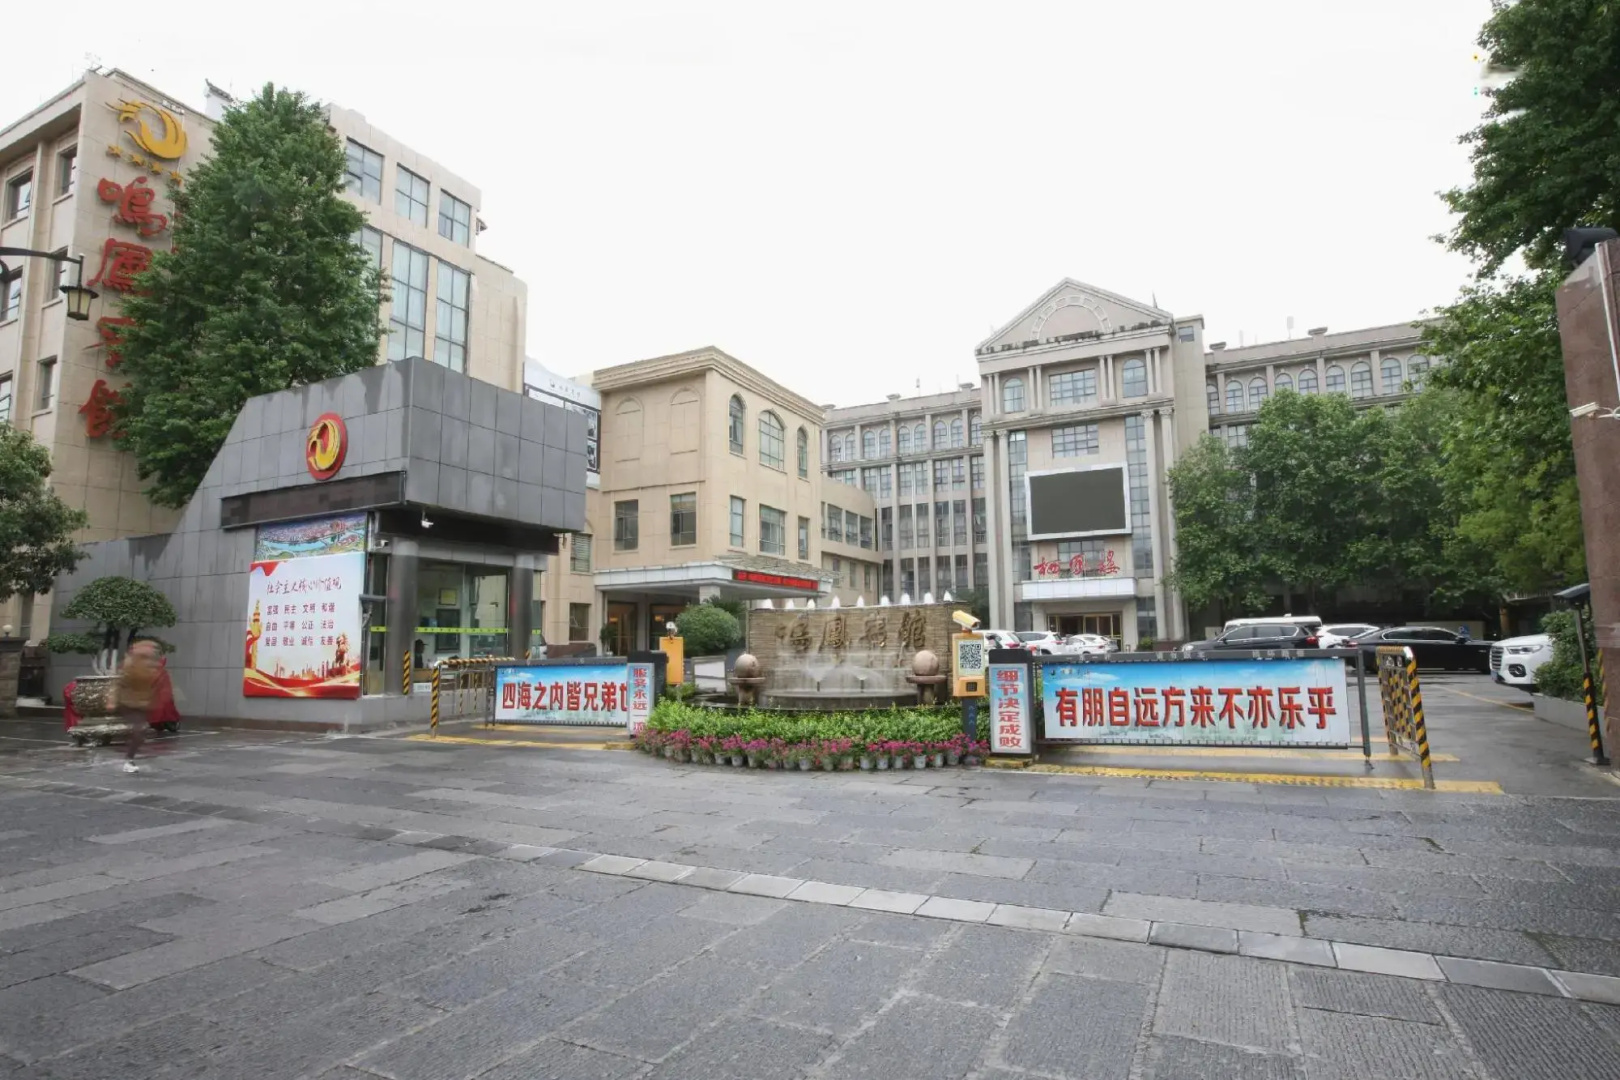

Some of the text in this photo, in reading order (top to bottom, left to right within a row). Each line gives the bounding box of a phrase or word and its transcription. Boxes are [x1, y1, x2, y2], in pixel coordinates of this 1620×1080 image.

[996, 669, 1022, 748] 细节决定成败
[1056, 686, 1336, 729] 有朋自远方来不亦乐乎
